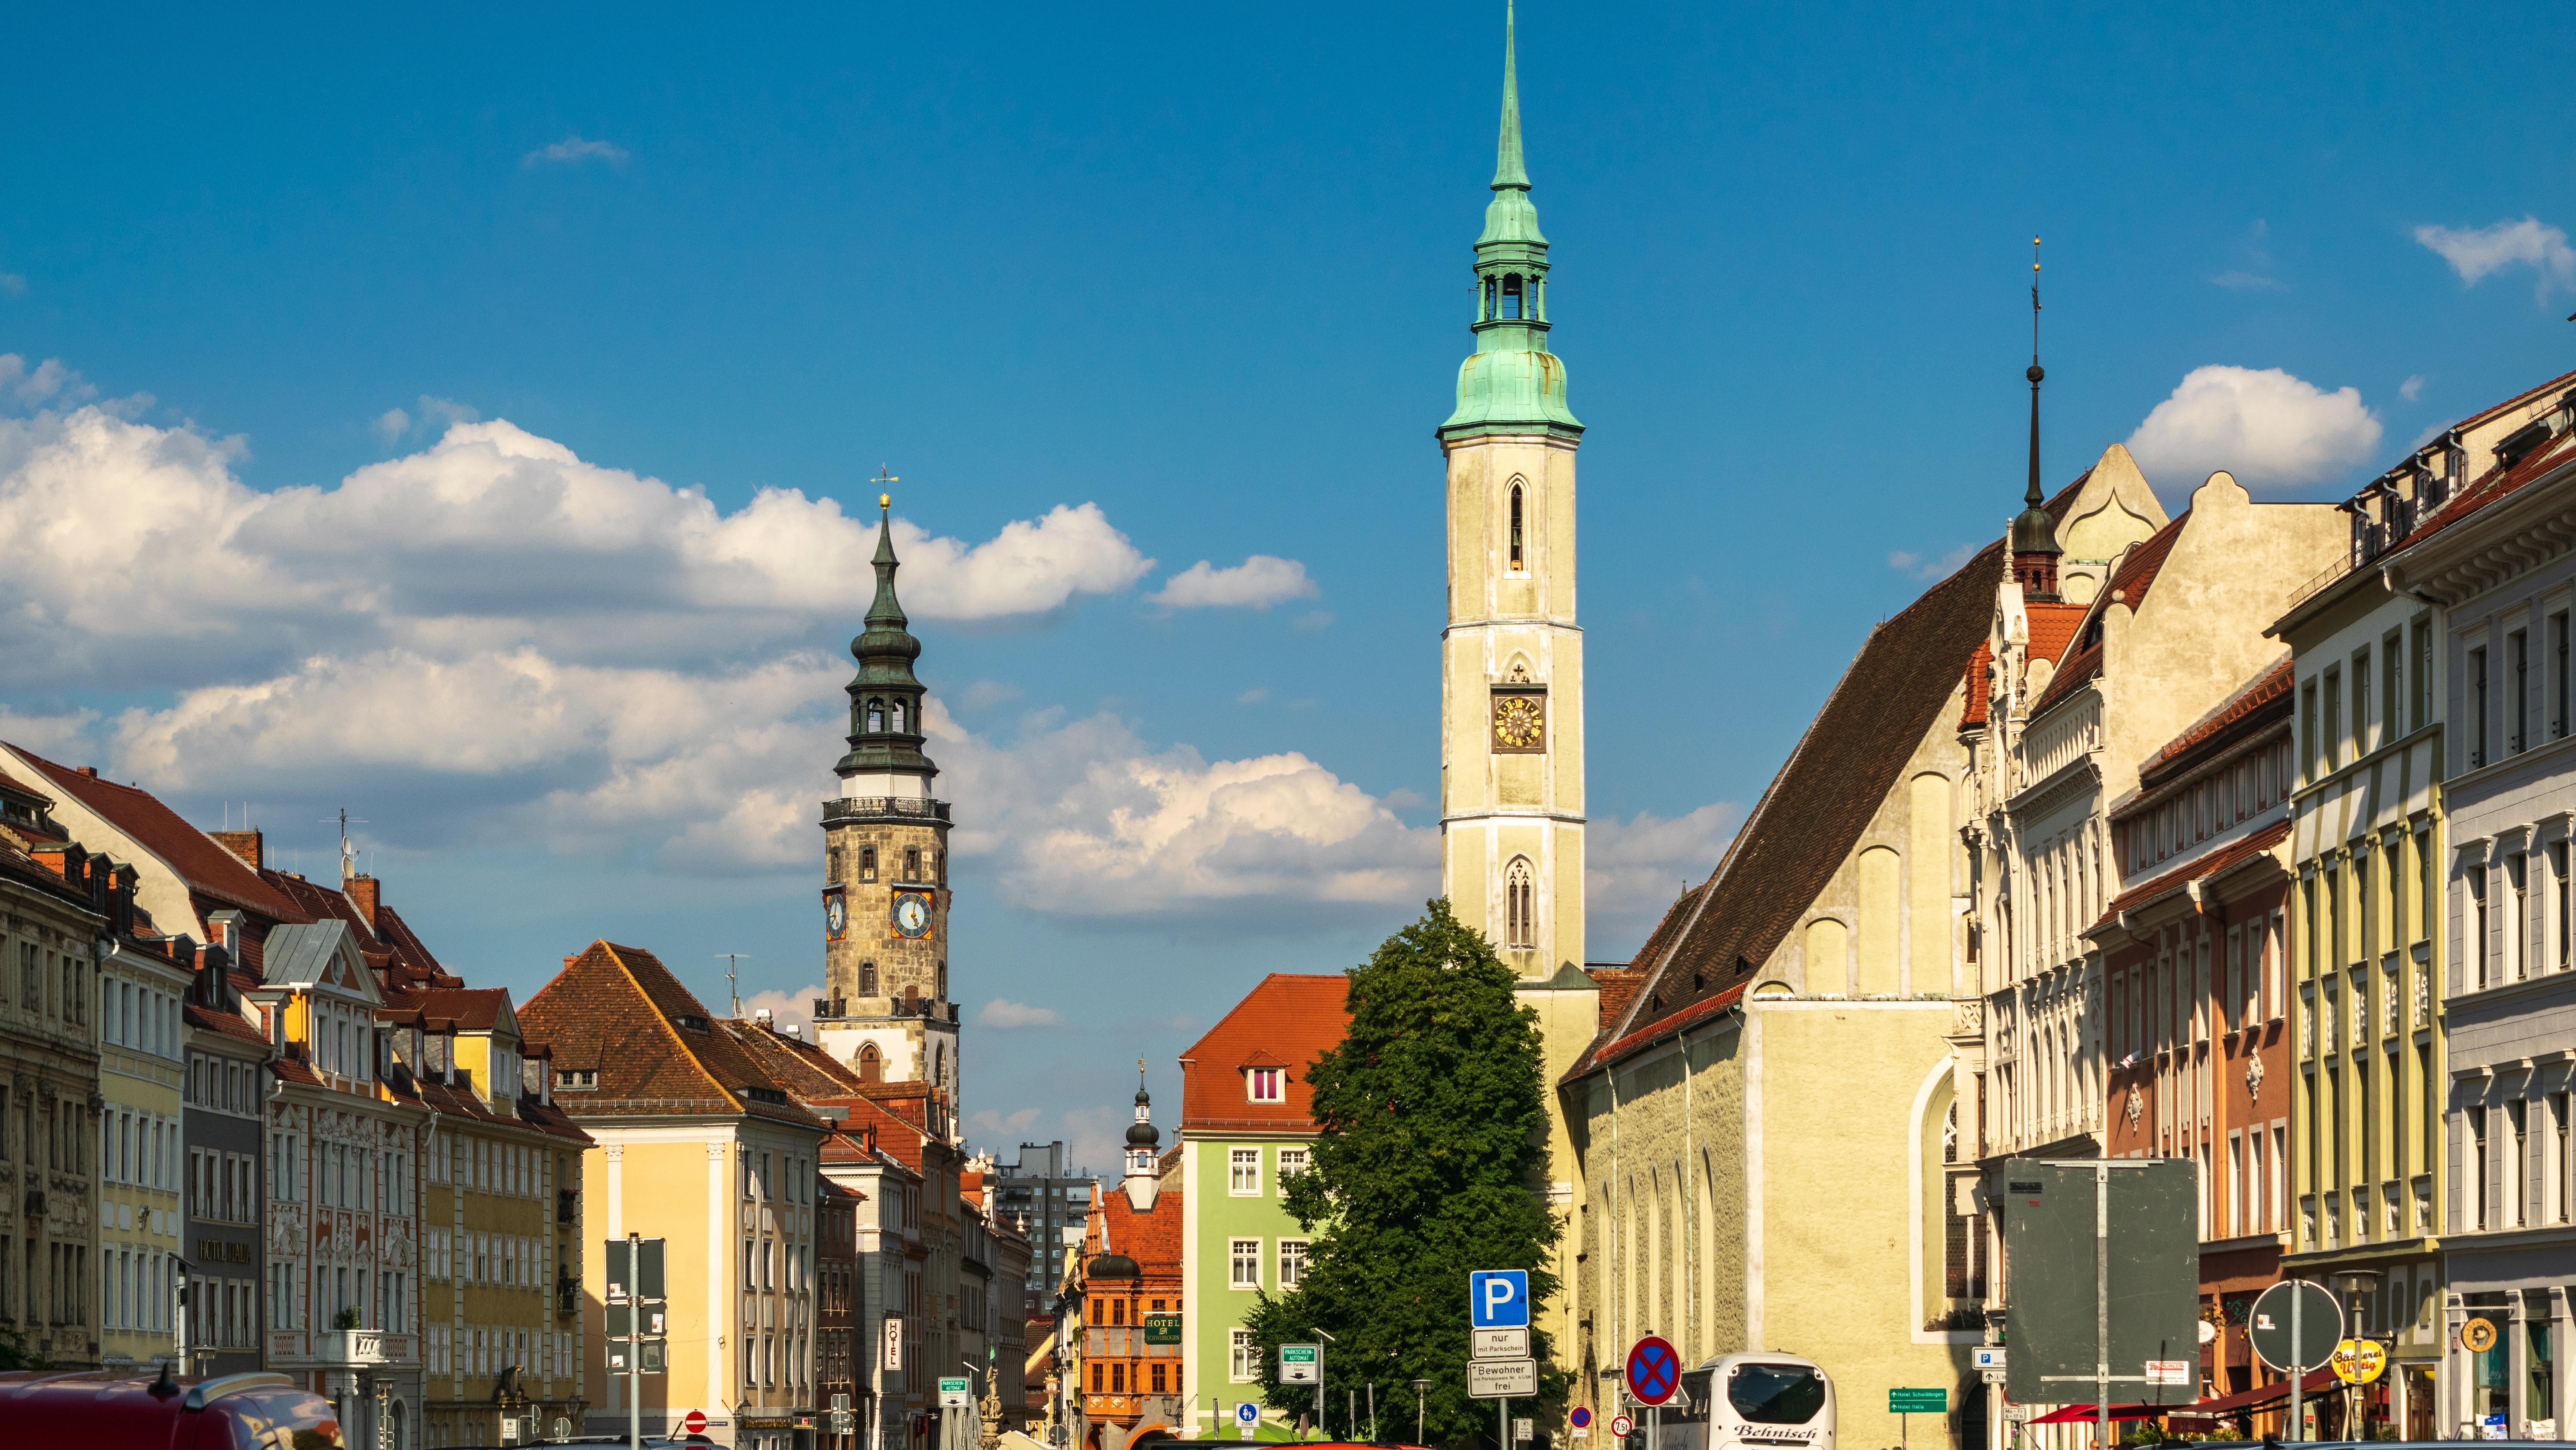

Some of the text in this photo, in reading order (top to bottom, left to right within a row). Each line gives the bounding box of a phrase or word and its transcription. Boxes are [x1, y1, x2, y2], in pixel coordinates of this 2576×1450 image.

[1514, 699, 1523, 708] XII
[1497, 708, 1507, 717] X
[200, 1239, 226, 1260] HOTEL
[1485, 1279, 1514, 1319] P
[889, 1322, 897, 1365] HOTEL
[2333, 1349, 2383, 1363] Bäcerei
[1479, 1366, 1525, 1375] Bewohner
[1495, 1382, 1510, 1390] frei
[1734, 1425, 1817, 1438] Behnisch
